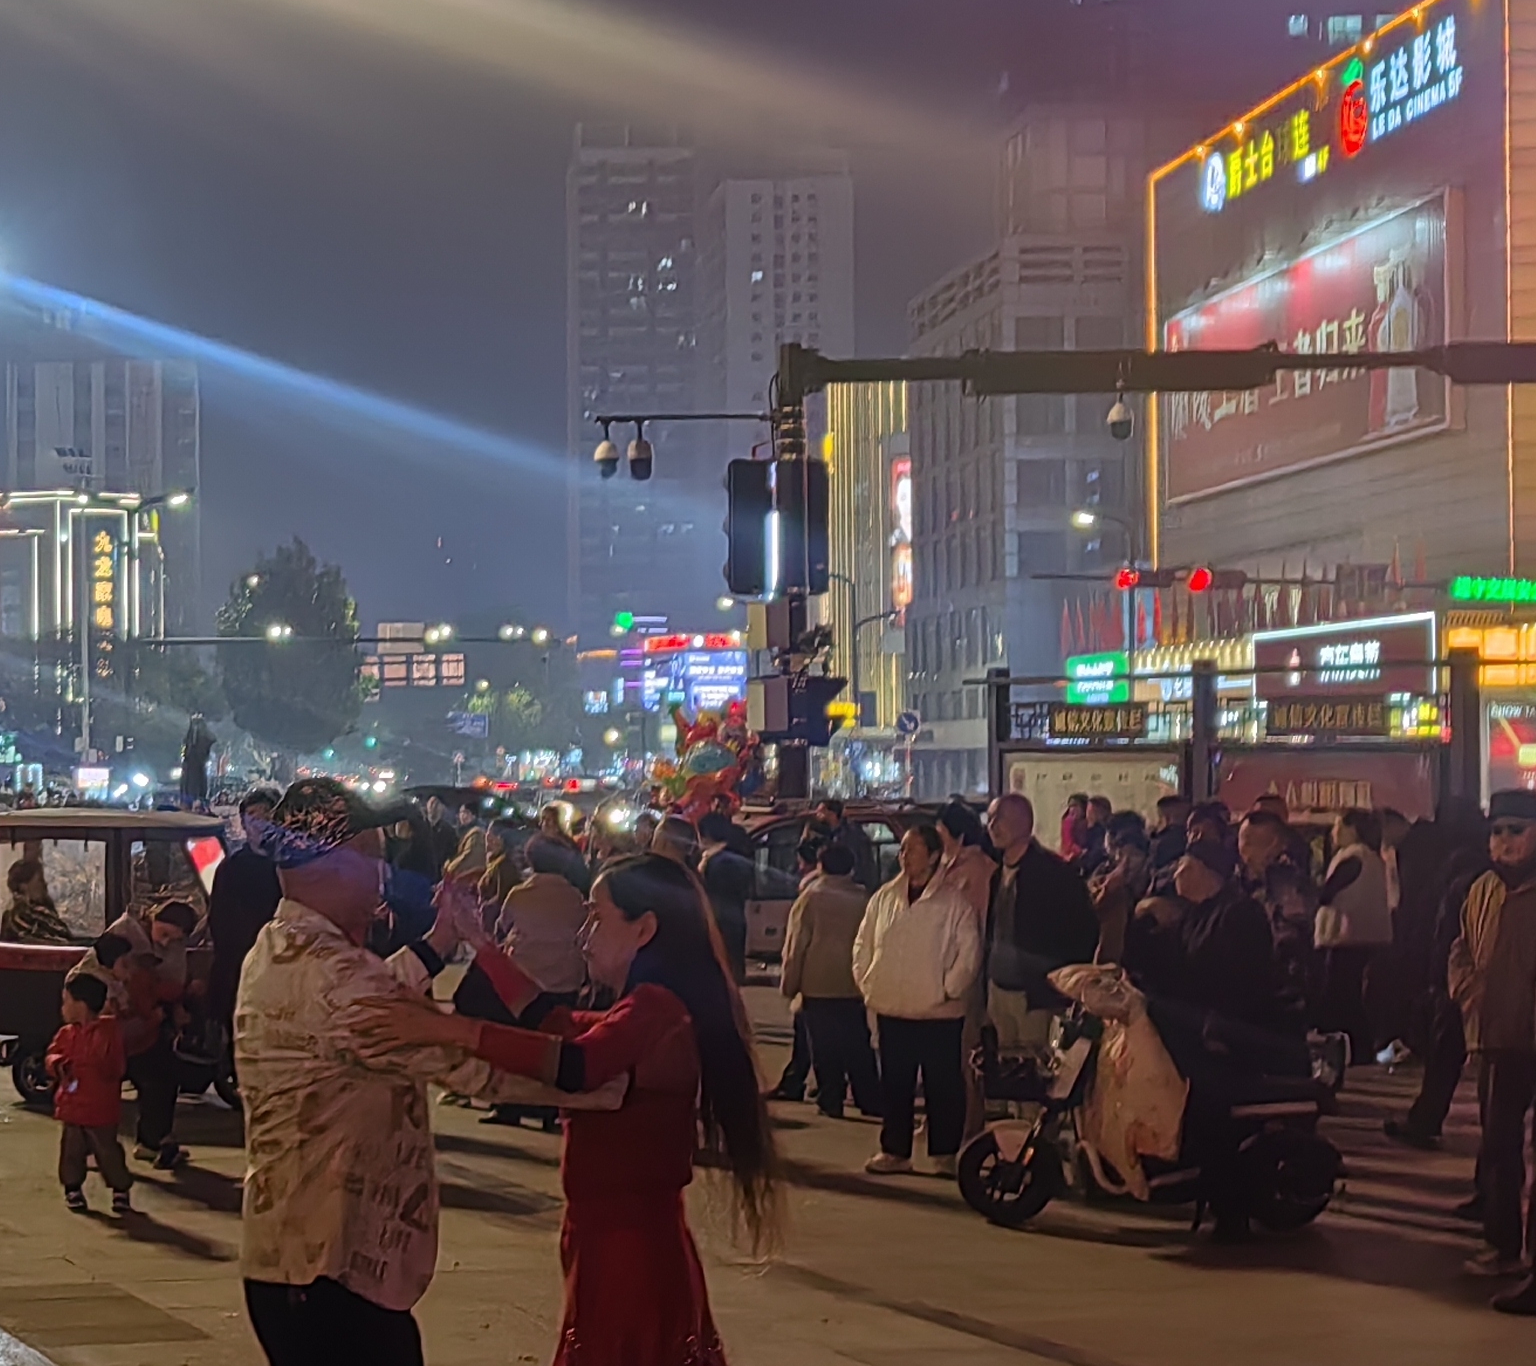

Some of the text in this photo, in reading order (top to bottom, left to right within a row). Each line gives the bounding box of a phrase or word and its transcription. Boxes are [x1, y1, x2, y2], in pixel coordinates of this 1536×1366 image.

[1370, 14, 1458, 114] 乐达影城
[1371, 116, 1386, 140] LE
[1405, 82, 1447, 123] CINEMA
